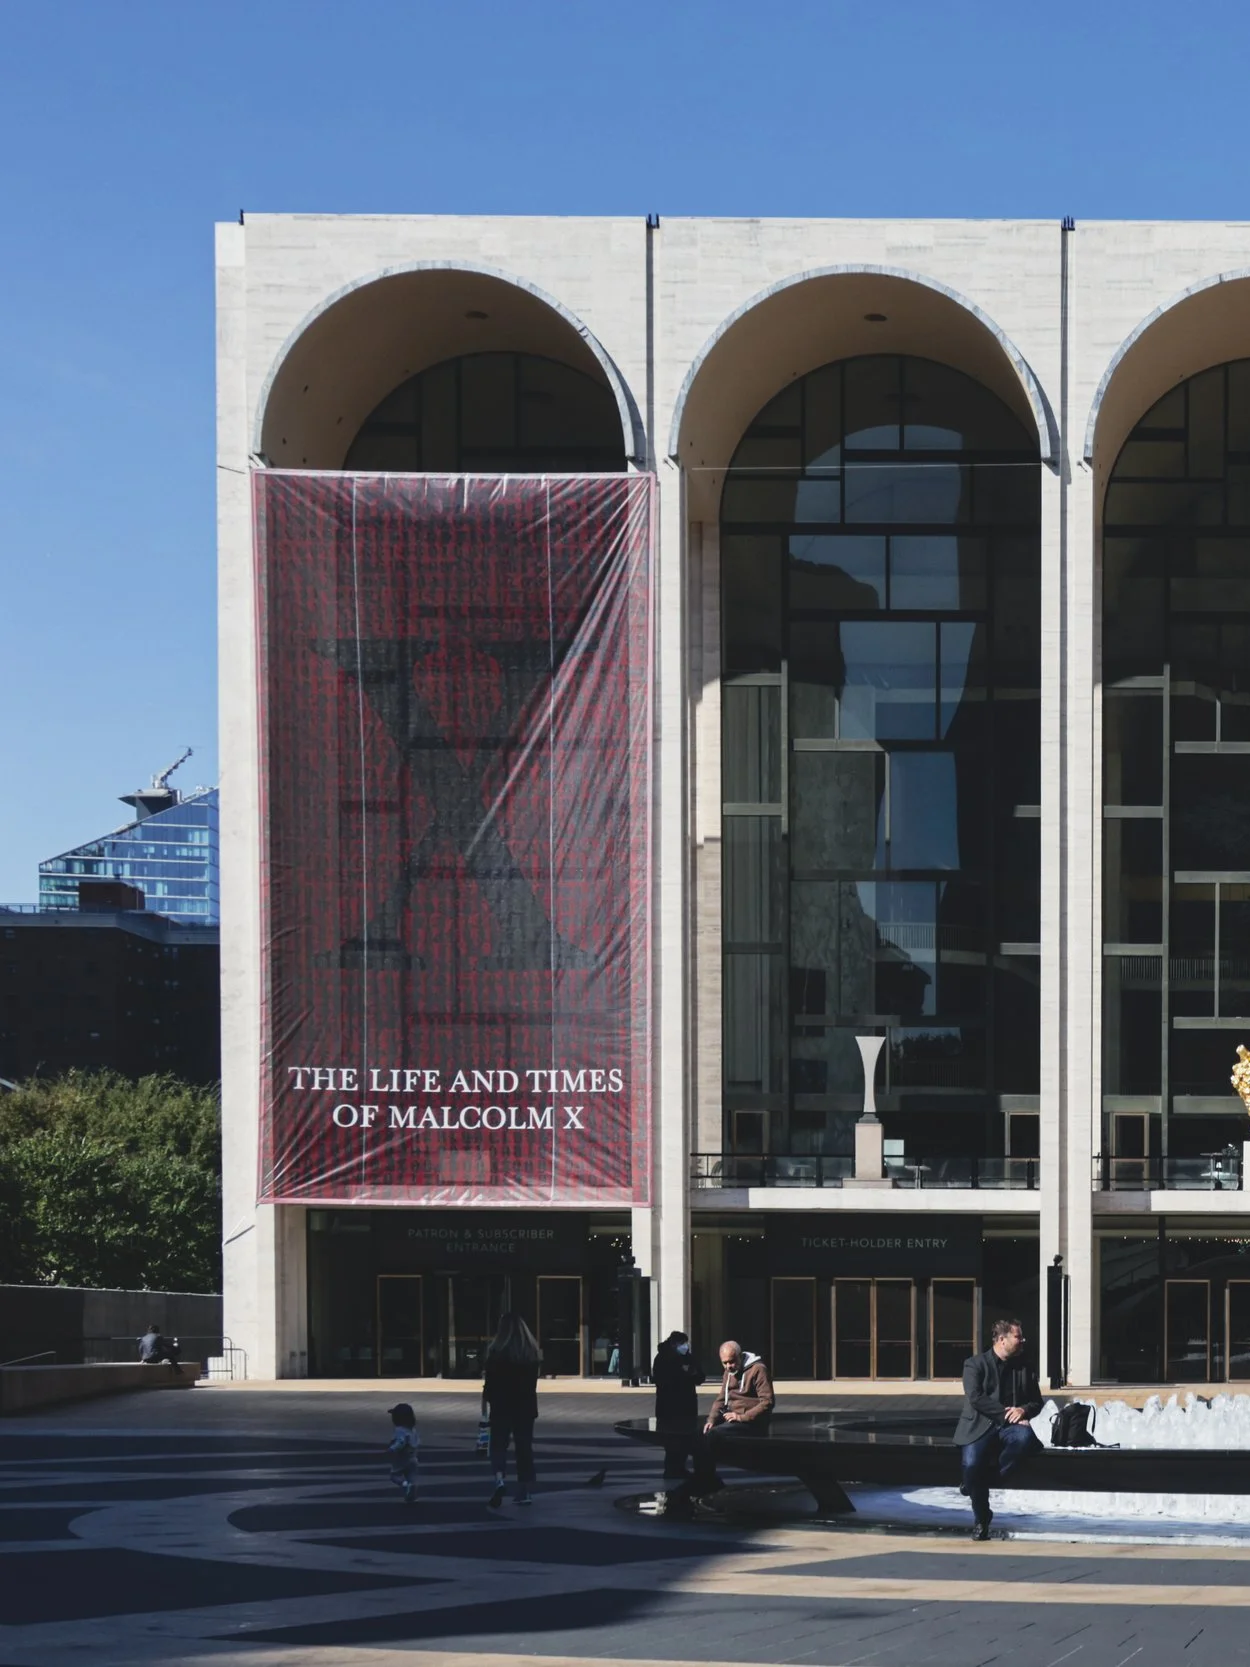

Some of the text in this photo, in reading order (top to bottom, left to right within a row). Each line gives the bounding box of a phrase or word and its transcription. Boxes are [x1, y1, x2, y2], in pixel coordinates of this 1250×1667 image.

[288, 1067, 624, 1093] THE LIFE AND TIMES
[332, 1104, 585, 1130] OF MALCOLM X
[407, 1228, 555, 1240] PATRON & SUBSCRIBER
[445, 1241, 517, 1253] ENTRANCE
[800, 1236, 949, 1249] TICKET-HOLDER ENTRY
